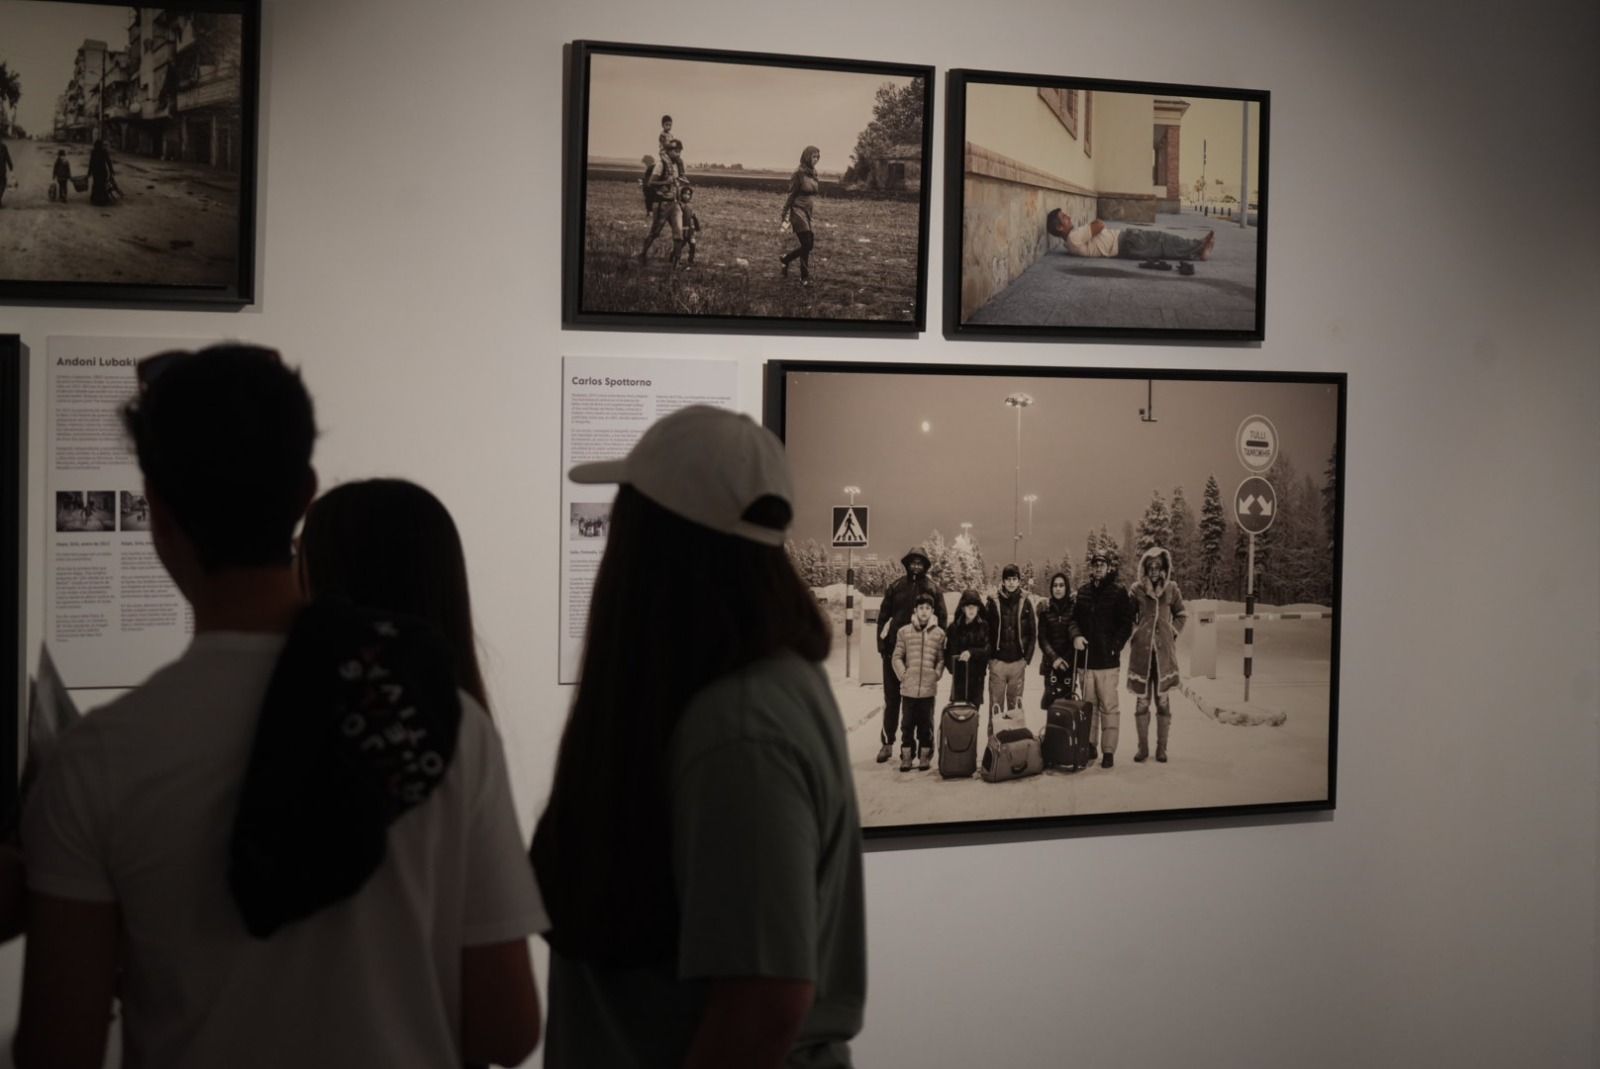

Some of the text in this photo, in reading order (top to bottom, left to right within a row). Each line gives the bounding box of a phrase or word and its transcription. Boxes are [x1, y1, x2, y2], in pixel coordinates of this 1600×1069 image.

[56, 357, 136, 367] Andoni Lubaki
[571, 376, 651, 388] Carlos Spottorno
